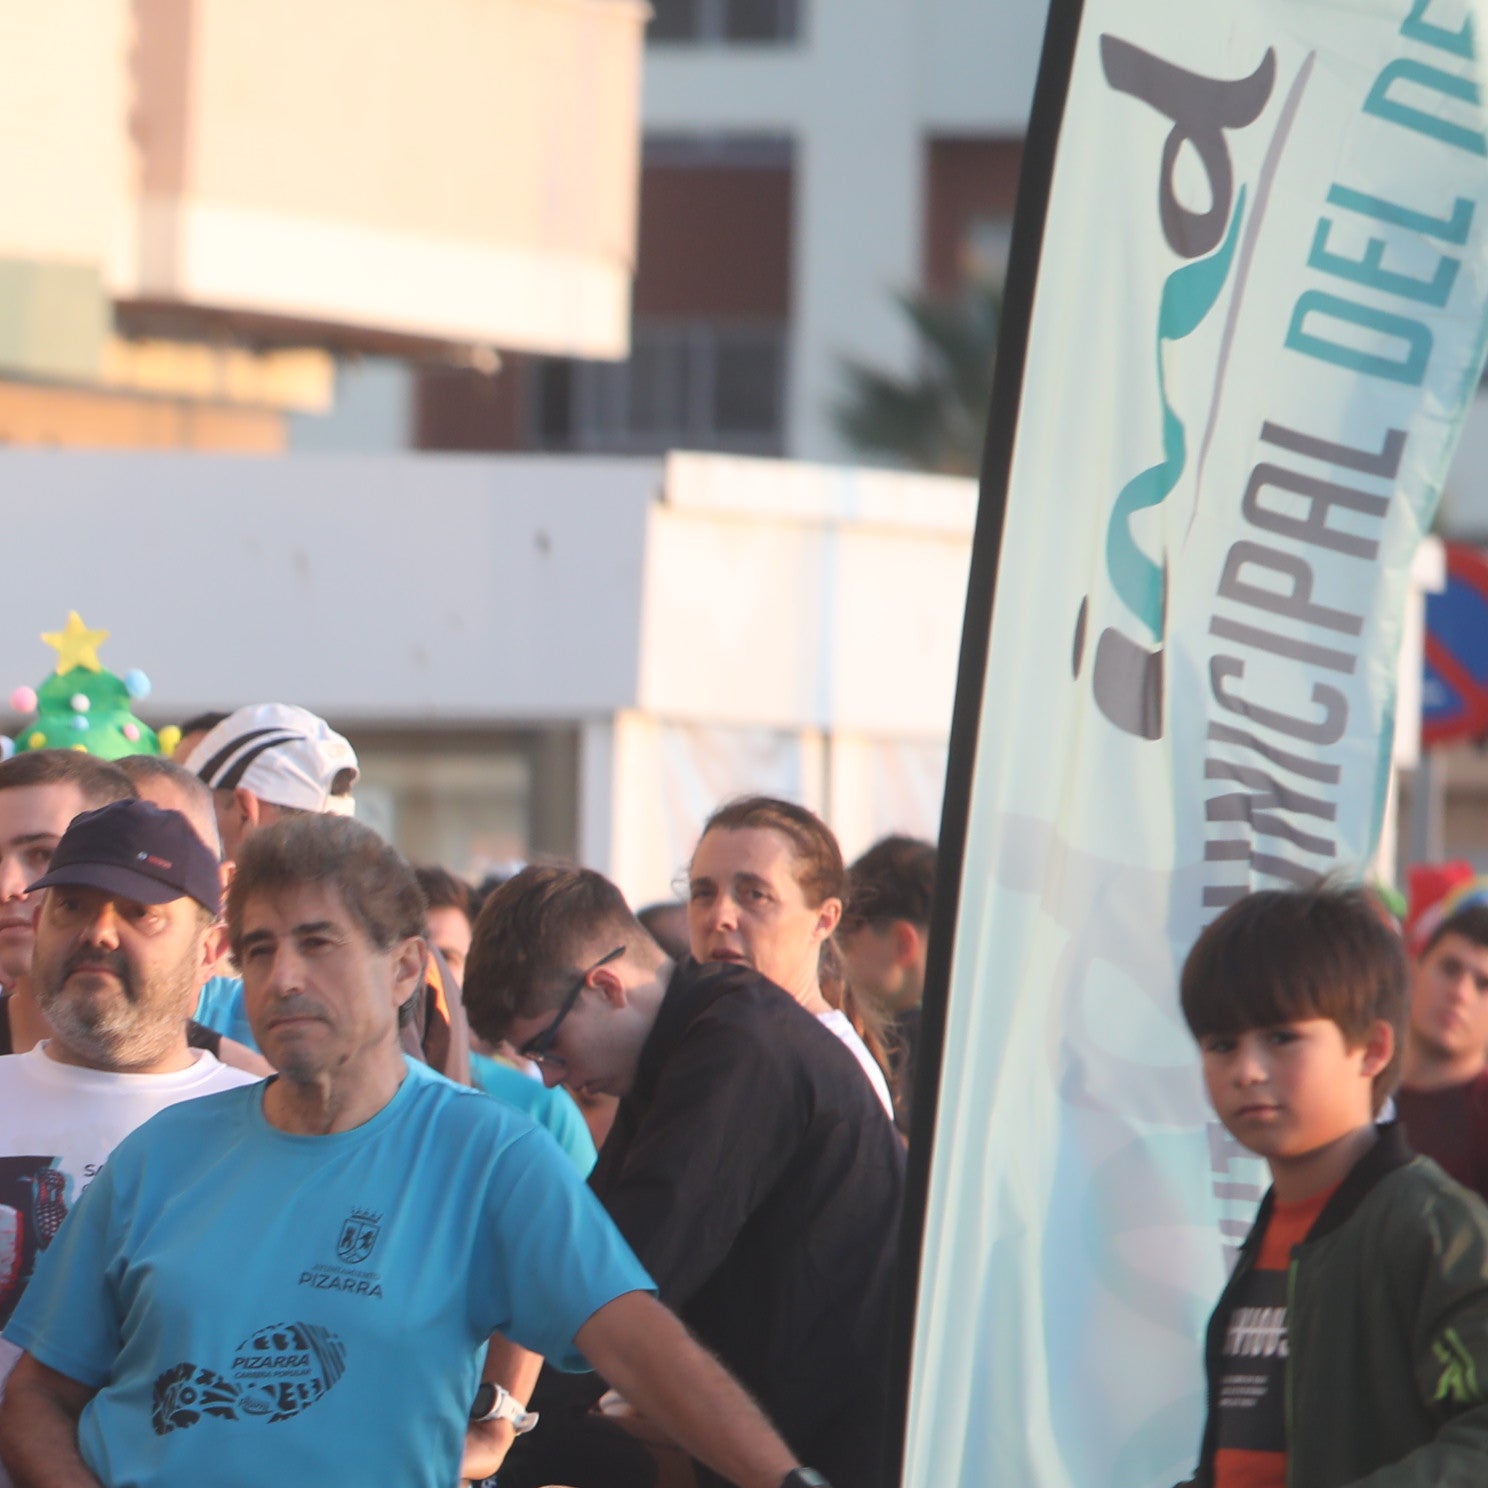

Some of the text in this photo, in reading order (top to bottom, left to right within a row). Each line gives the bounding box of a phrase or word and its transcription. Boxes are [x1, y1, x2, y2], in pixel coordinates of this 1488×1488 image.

[1284, 182, 1476, 388] DEL
[297, 1271, 383, 1299] PIZARRA
[231, 1354, 310, 1370] PIZARRA
